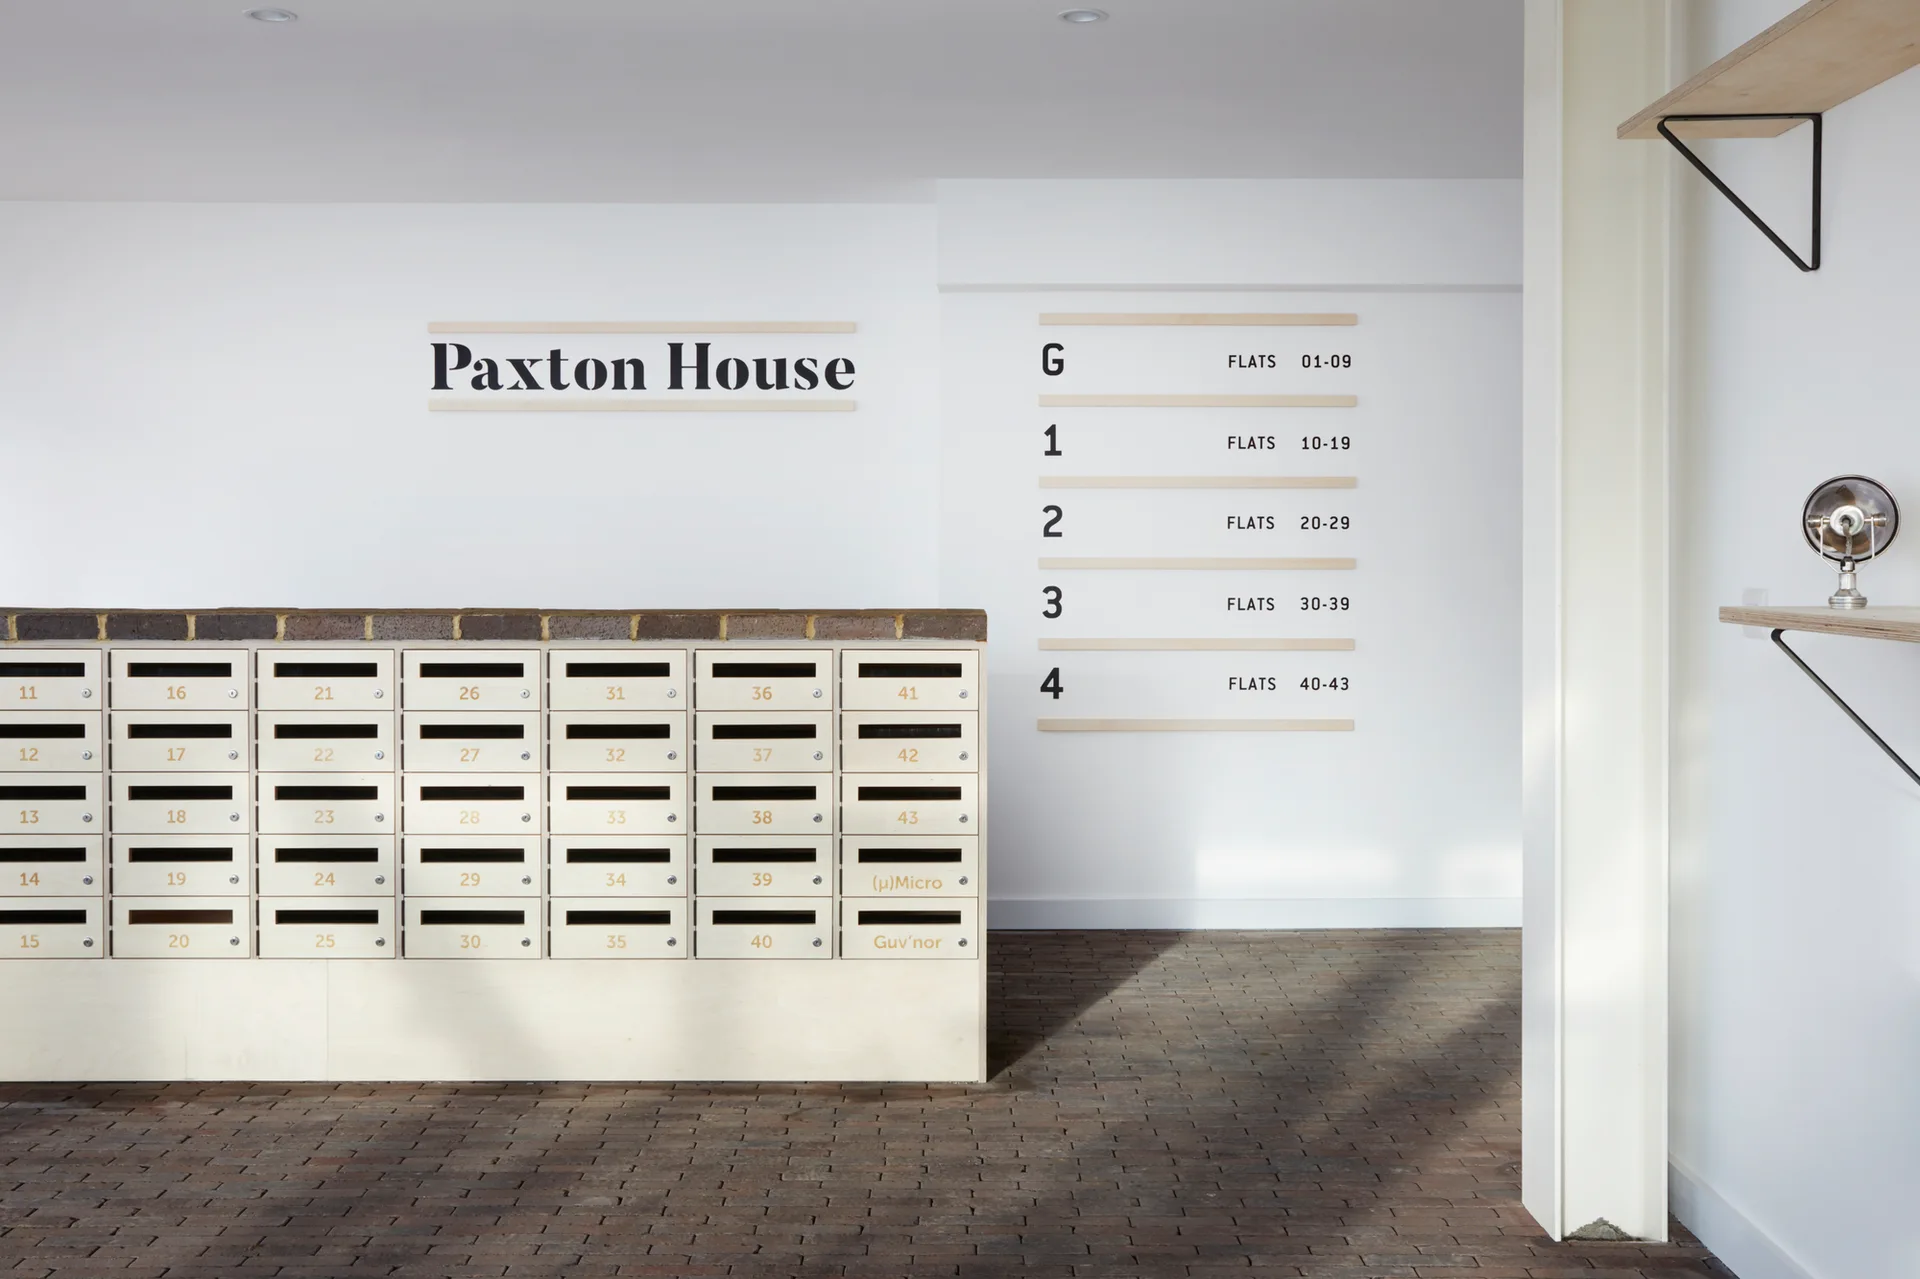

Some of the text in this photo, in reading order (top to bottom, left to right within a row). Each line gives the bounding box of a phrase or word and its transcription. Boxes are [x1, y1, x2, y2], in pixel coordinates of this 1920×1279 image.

[431, 343, 855, 390] Paxton House
[1043, 343, 1352, 375] G FLATS 01-09
[1045, 424, 1351, 456] 1 FLATS 10-19
[1043, 505, 1350, 537] 2 FLATS 20-29
[1043, 586, 1350, 618] 3 FLATS 30-39
[1040, 668, 1349, 699] 4 FLATS 40-43
[18, 685, 38, 702] 11
[167, 684, 188, 702] 16
[313, 685, 334, 701] 21
[458, 685, 482, 701] 26
[606, 686, 625, 702] 31
[752, 686, 773, 702] 36
[896, 686, 919, 701] 41
[18, 747, 40, 763] 12
[167, 746, 186, 763] 17
[313, 747, 334, 763] 22
[459, 747, 481, 764] 27
[606, 746, 626, 763] 32
[753, 747, 773, 763] 37
[897, 747, 920, 764] 42
[19, 808, 40, 826] 13
[167, 808, 187, 825] 18
[314, 807, 335, 825] 23
[459, 810, 481, 826] 28
[607, 810, 627, 826] 33
[752, 809, 773, 826] 38
[896, 810, 920, 826] 43
[19, 871, 41, 888] 14
[167, 871, 187, 887] 19
[313, 871, 337, 888] 24
[458, 872, 482, 888] 29
[606, 872, 626, 888] 34
[751, 871, 774, 888] 39
[19, 934, 40, 950] 15
[168, 934, 190, 949] 20
[315, 933, 337, 950] 25
[460, 934, 481, 950] 30
[606, 934, 628, 950] 35
[750, 934, 774, 950] 40
